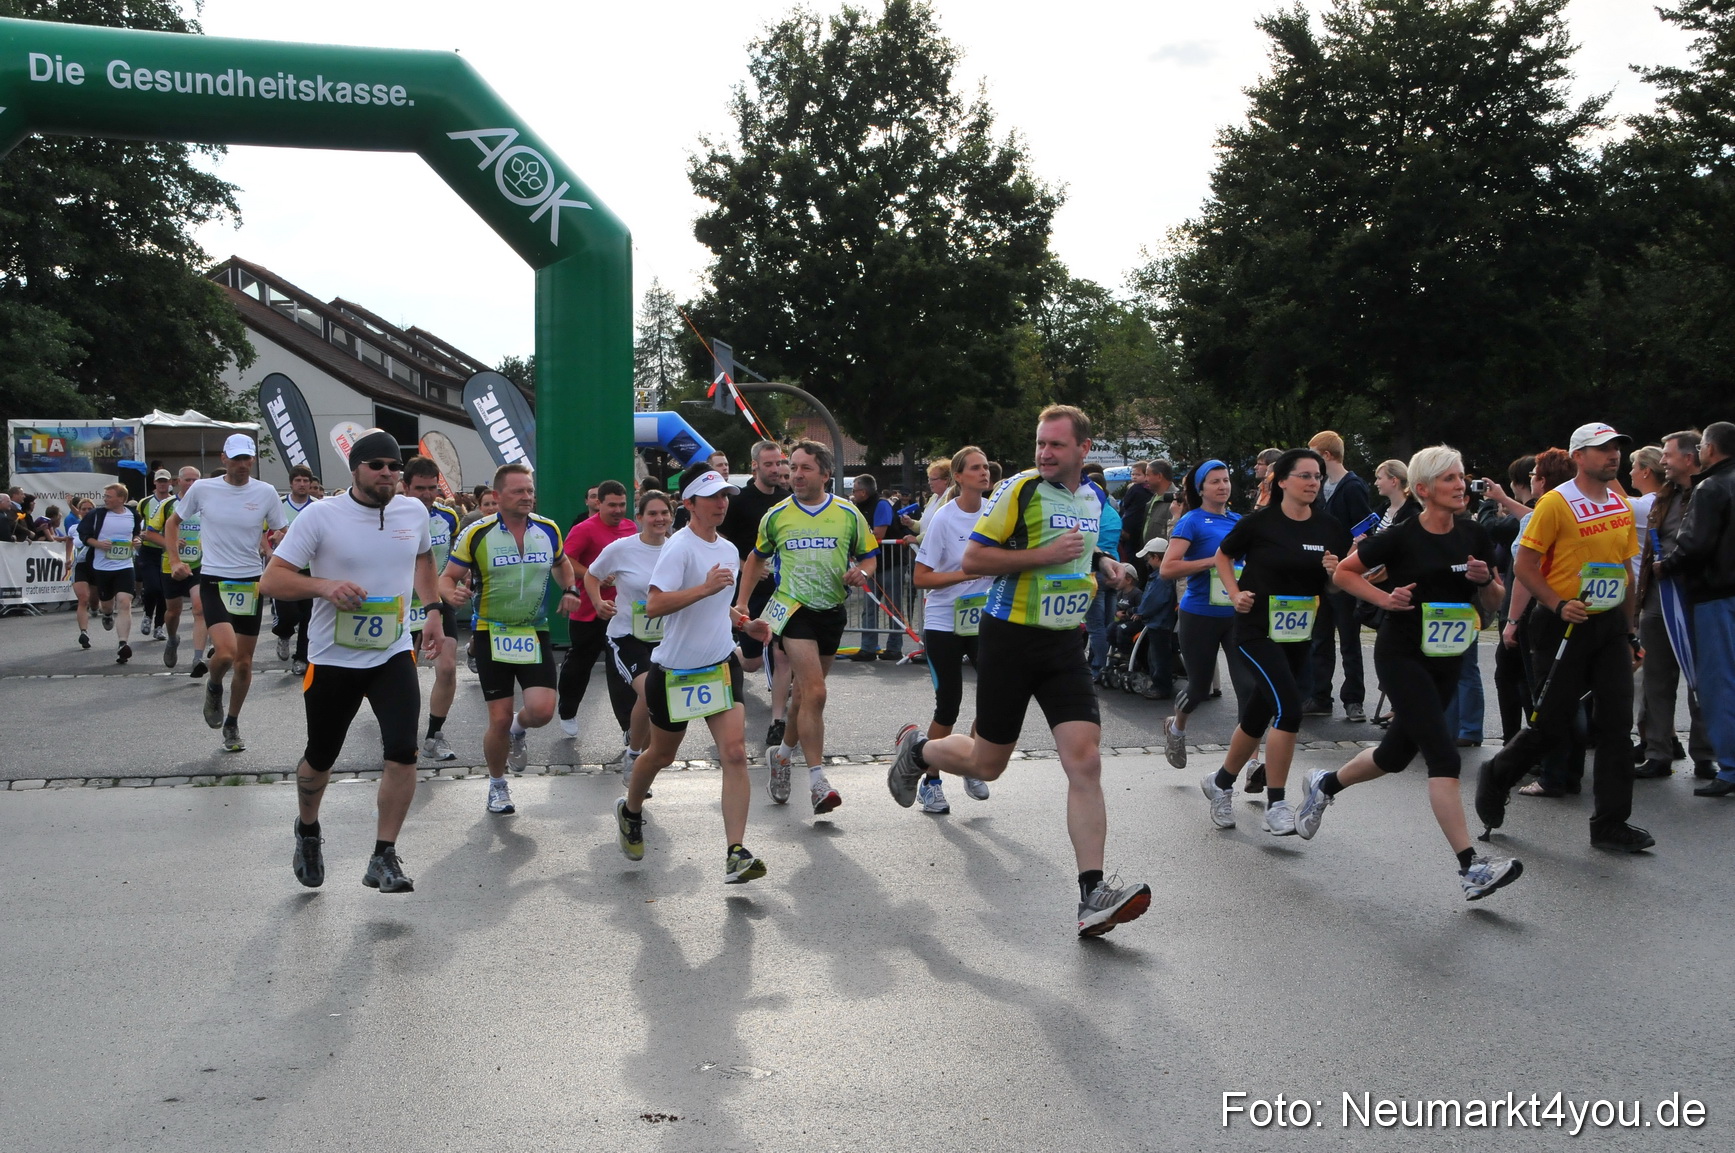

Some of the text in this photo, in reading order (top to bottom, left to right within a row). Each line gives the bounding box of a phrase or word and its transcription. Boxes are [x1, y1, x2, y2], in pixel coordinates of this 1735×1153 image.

[29, 52, 415, 108] Die Gesundheitskasse.
[446, 128, 593, 247] AOK
[19, 438, 123, 459] TLA Logistics
[1050, 503, 1083, 516] TEAM
[786, 528, 820, 537] TEAM
[1050, 514, 1098, 533] BOCK
[1579, 516, 1632, 537] MAX BÖG
[431, 534, 447, 546] CK
[785, 537, 838, 551] BOCK
[1302, 544, 1325, 552] THULE
[179, 546, 198, 556] 066
[493, 552, 547, 567] BOCK
[26, 557, 63, 583] swn
[1451, 564, 1468, 573] THU
[1585, 579, 1619, 599] 402
[227, 592, 245, 606] 79
[1042, 593, 1089, 617] 1052
[765, 598, 787, 621] 1058
[959, 607, 981, 626] 78
[352, 615, 383, 637] 78
[643, 614, 664, 631] 77
[1274, 611, 1308, 630] 264
[1428, 621, 1467, 643] 272
[493, 636, 534, 652] 1046
[681, 684, 712, 708] 76
